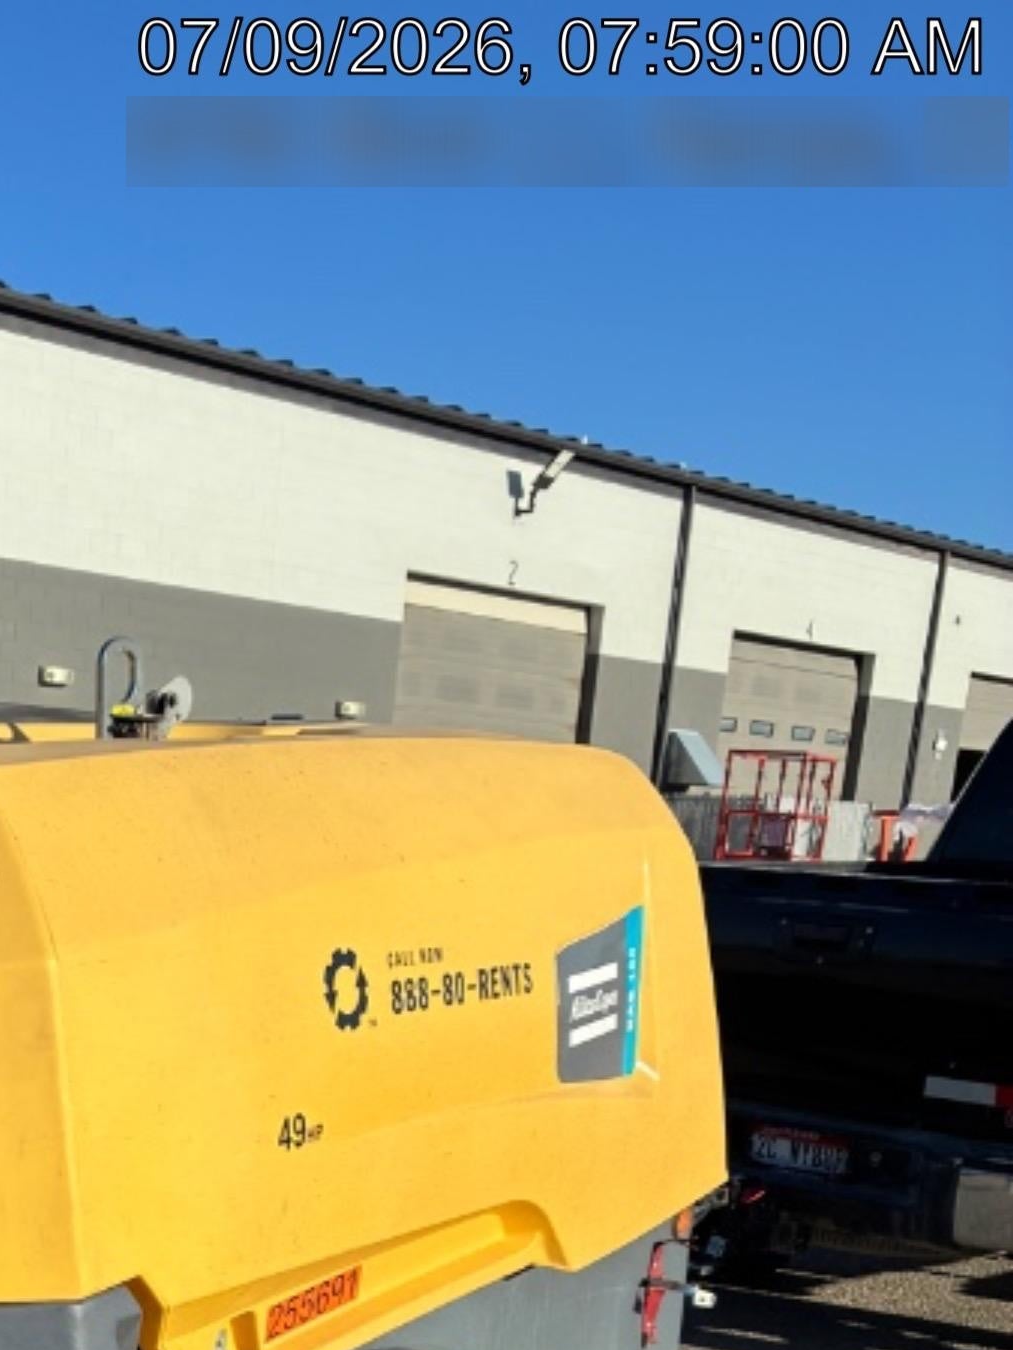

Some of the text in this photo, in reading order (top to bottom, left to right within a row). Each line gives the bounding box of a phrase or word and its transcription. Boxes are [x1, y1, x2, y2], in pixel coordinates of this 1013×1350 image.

[508, 559, 519, 586] 2
[390, 962, 534, 1015] 888-80-RENTS
[267, 1267, 357, 1340] 255691
